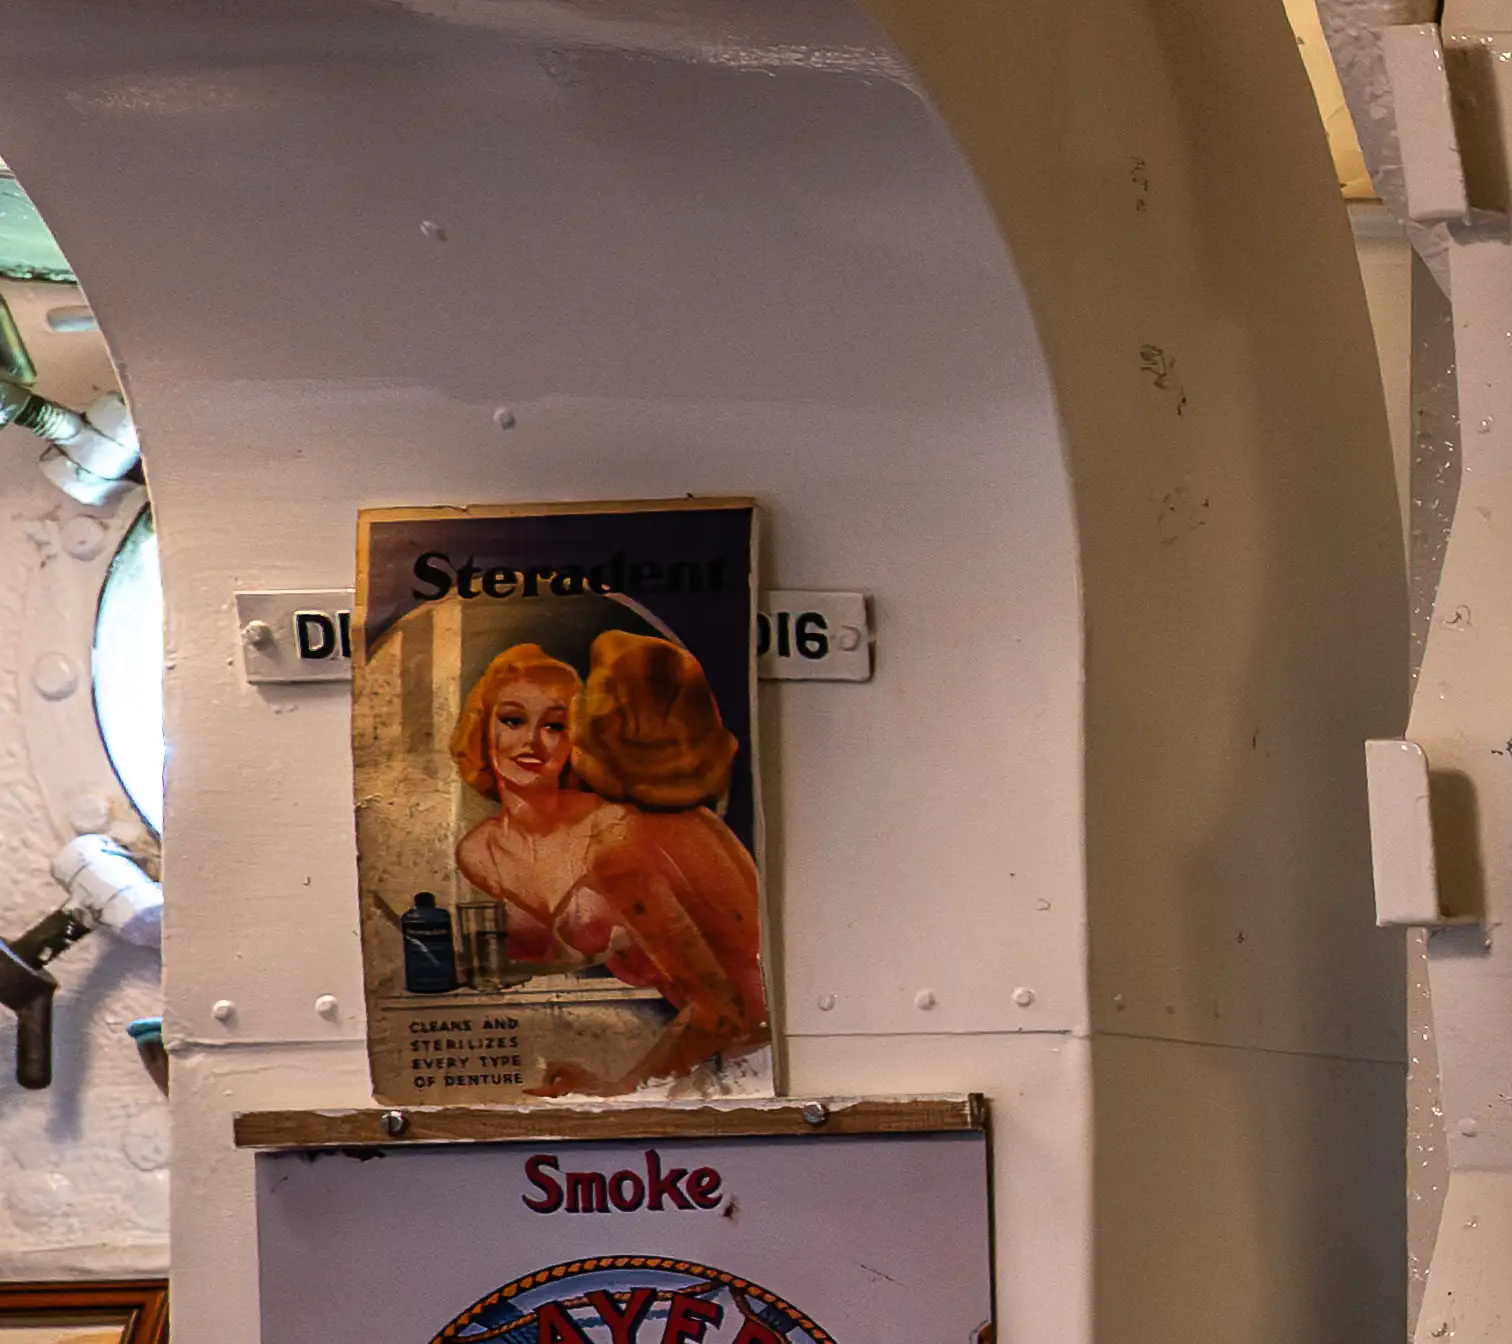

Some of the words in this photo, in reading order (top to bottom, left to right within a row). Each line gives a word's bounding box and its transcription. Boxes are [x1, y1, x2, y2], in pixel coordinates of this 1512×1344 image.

[412, 552, 726, 600] Steradent
[409, 1018, 474, 1034] CLEANS
[482, 1016, 519, 1031] AND
[410, 1036, 520, 1052] STERILIZES
[411, 1055, 471, 1070] EVERY
[479, 1054, 522, 1069] TYPE
[413, 1074, 437, 1088] OF
[443, 1072, 524, 1088] DENTURE
[522, 1149, 723, 1215] Smoke
